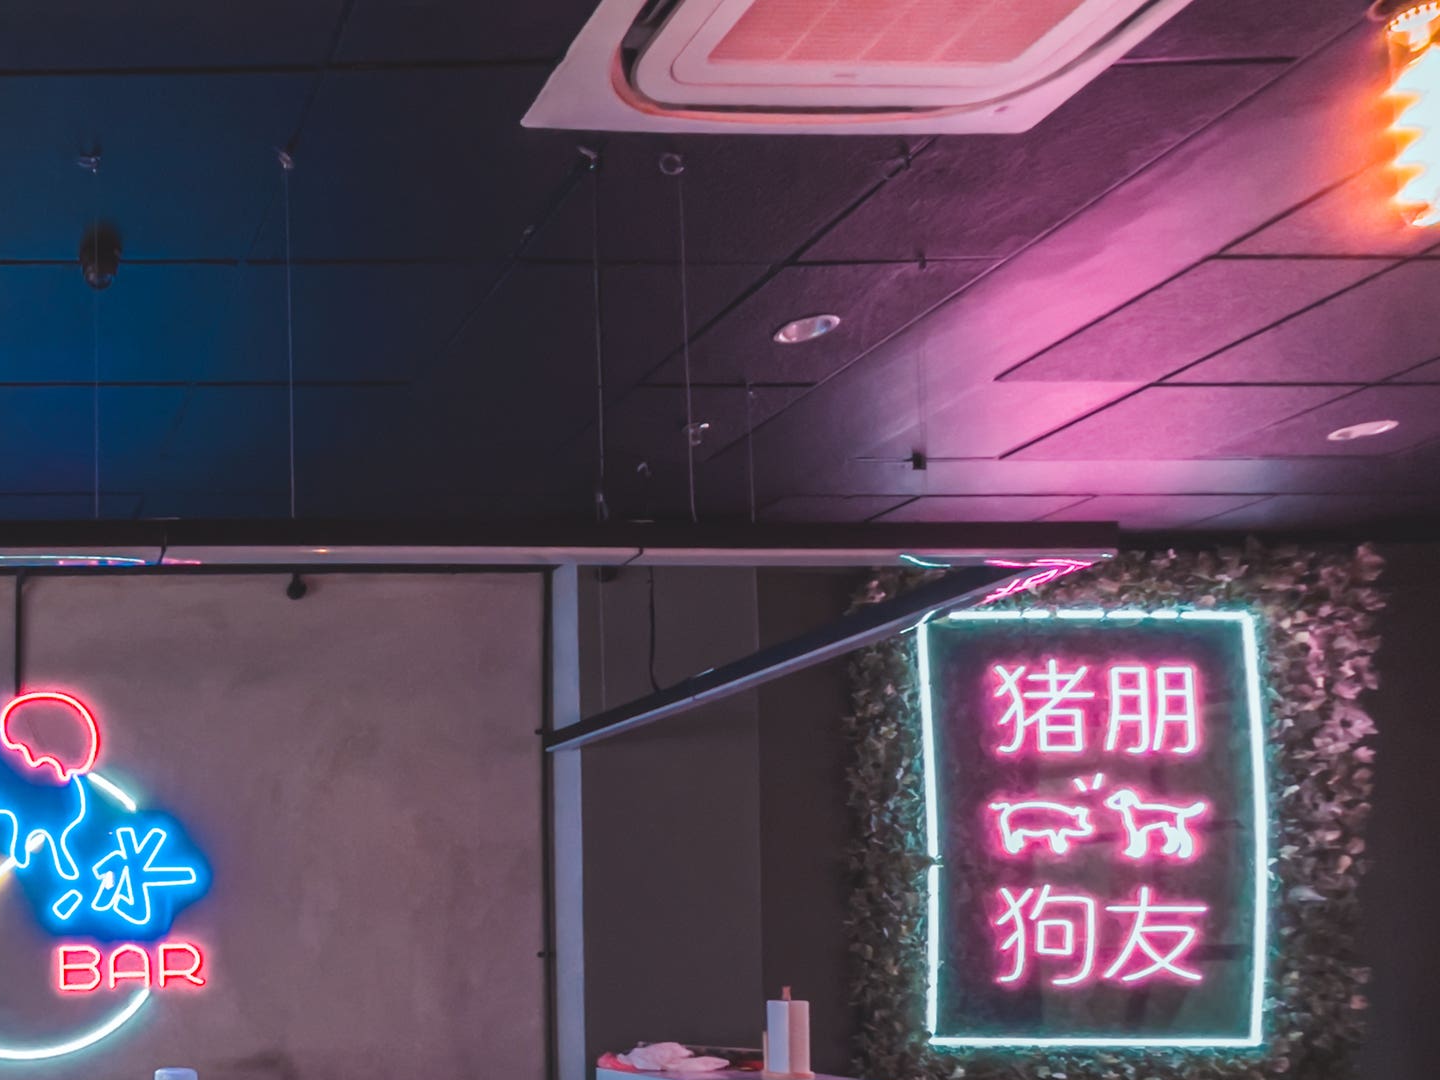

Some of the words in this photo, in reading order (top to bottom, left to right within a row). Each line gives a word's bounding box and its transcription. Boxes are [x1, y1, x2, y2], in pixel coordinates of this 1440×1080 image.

[993, 658, 1197, 755] 猪朋
[58, 943, 206, 993] BAR
[994, 883, 1209, 986] 狗友
